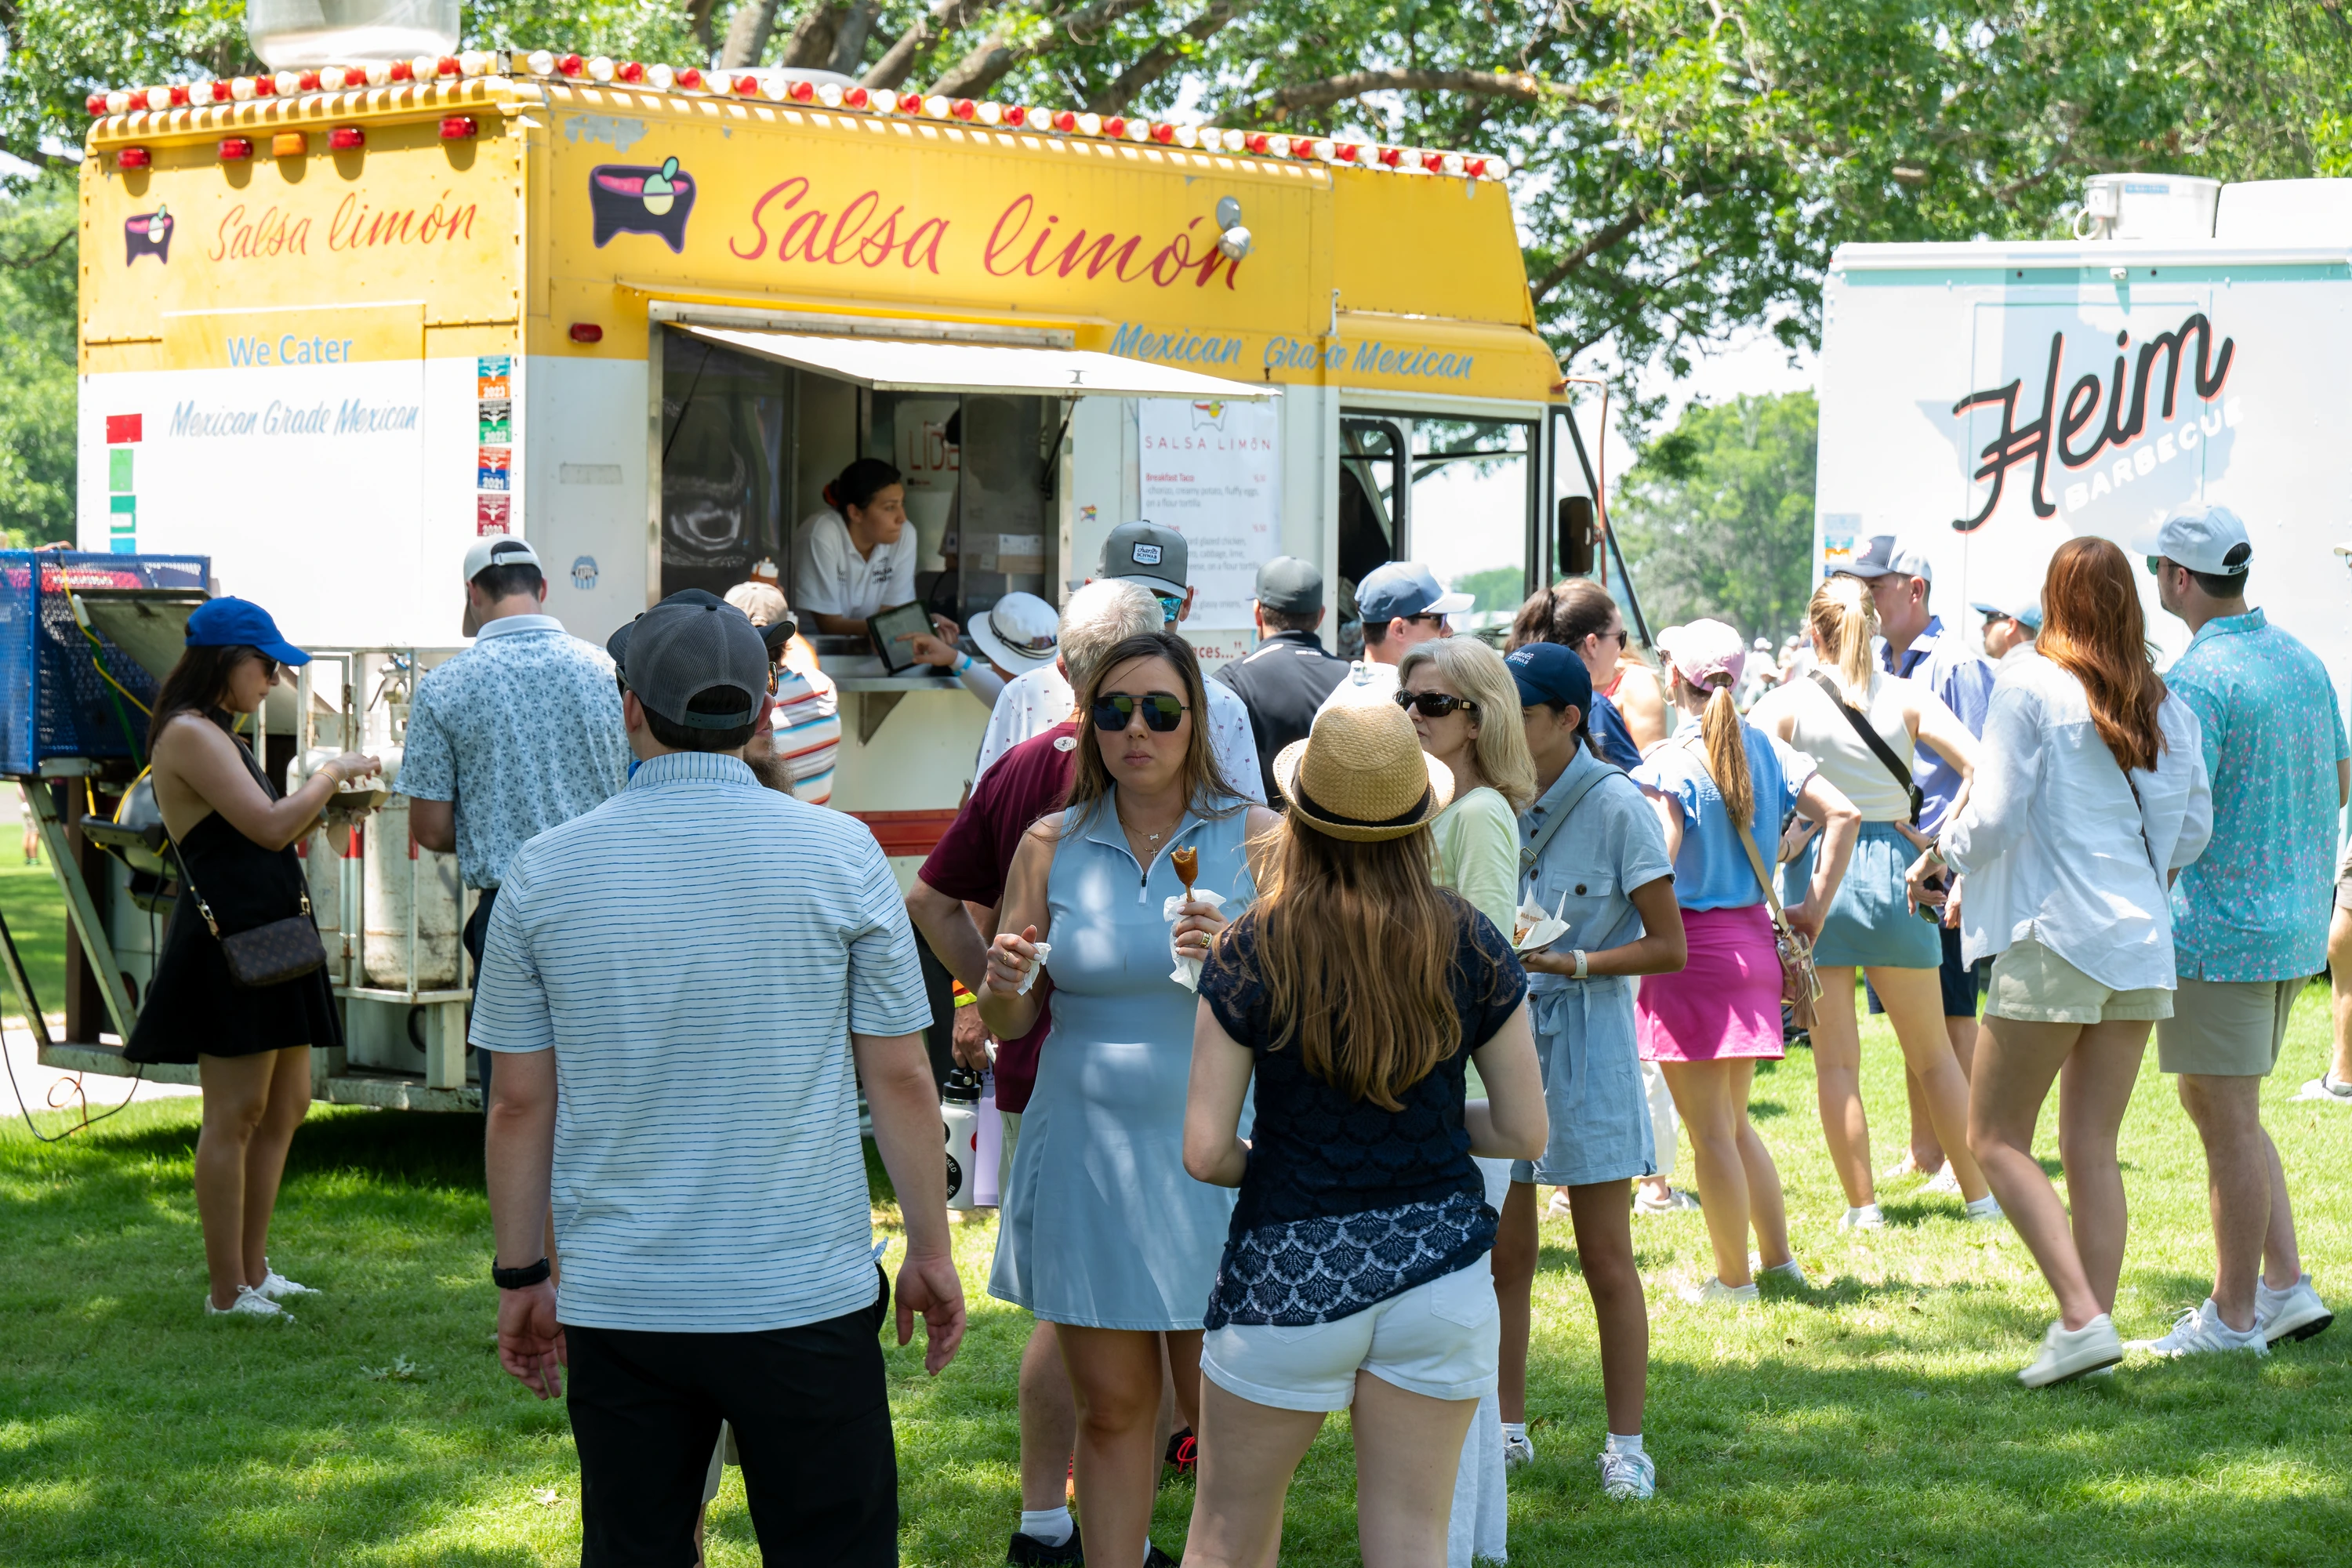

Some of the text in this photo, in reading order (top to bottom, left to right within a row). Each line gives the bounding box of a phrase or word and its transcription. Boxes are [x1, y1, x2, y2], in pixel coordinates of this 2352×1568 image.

[208, 189, 476, 261] Salsa limón
[729, 176, 1241, 291] Salsa limón
[227, 335, 353, 366] We Cater
[1109, 321, 1474, 380] Mexican Grade Mexican
[169, 397, 419, 437] Mexican Grade Mexican
[1145, 435, 1207, 450] SALSA
[1951, 312, 2236, 535] Heim
[1145, 472, 1178, 482] Breakfast
[1179, 473, 1195, 483] Taco
[2064, 395, 2244, 513] BARBECUE
